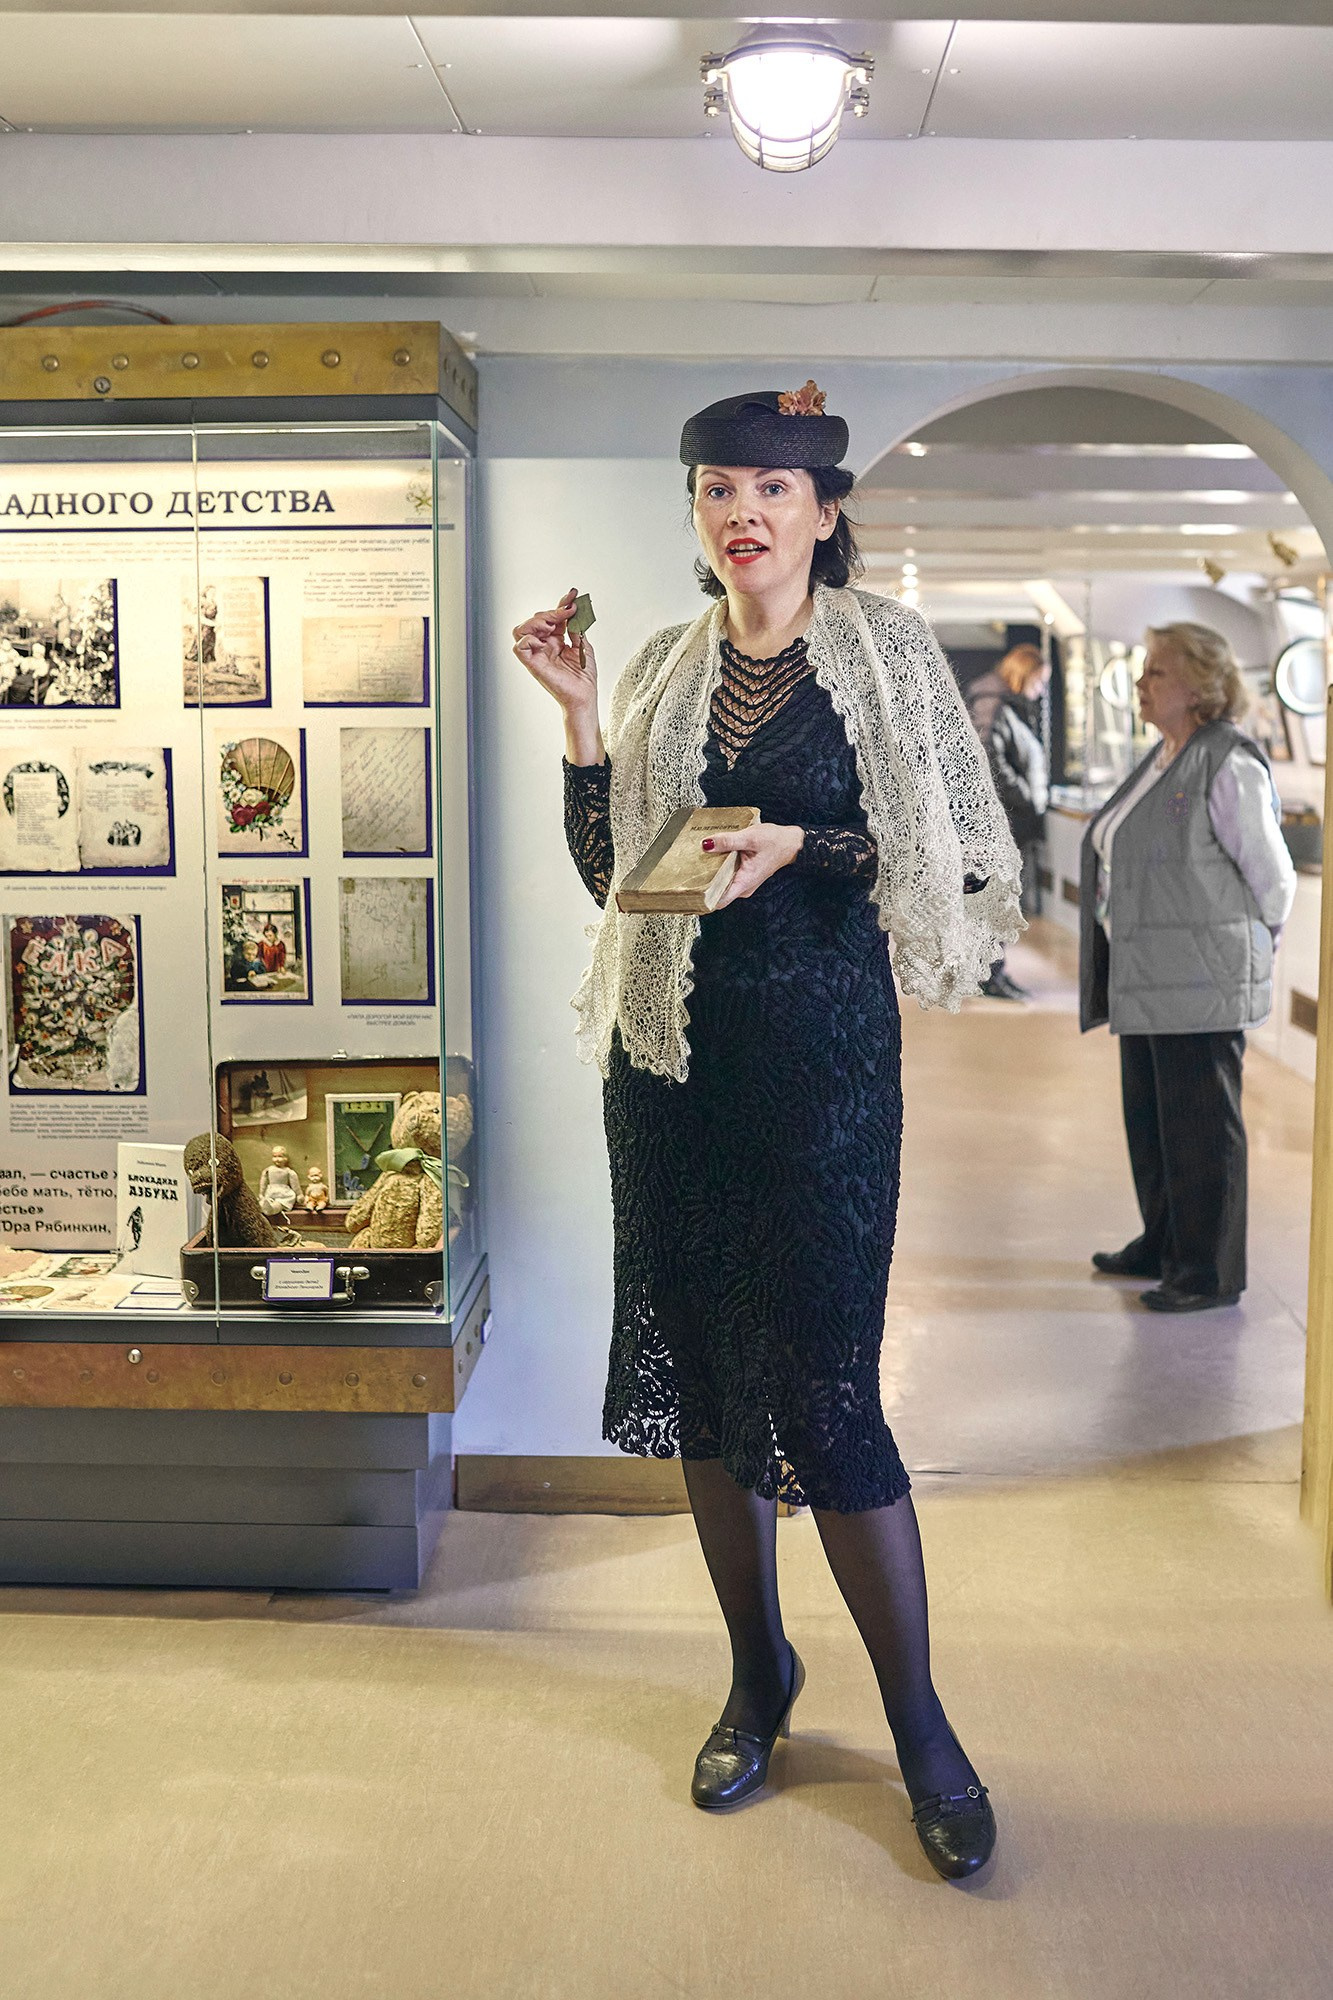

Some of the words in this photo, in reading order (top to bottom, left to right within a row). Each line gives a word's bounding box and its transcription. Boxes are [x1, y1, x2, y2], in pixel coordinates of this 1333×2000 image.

[0, 491, 154, 518] АДНОГО
[166, 489, 336, 518] ДЕТСТВА
[21, 935, 127, 977] ЁЛКА
[49, 1169, 109, 1180] счастье
[128, 1174, 178, 1186] БЛОКАДНАЯ
[0, 1184, 28, 1197] ебе
[33, 1188, 73, 1198] мать,
[77, 1184, 117, 1199] тётю,
[129, 1185, 179, 1201] АЗБУКА
[0, 1204, 44, 1215] стье»
[35, 1219, 112, 1234] Рябинкин,
